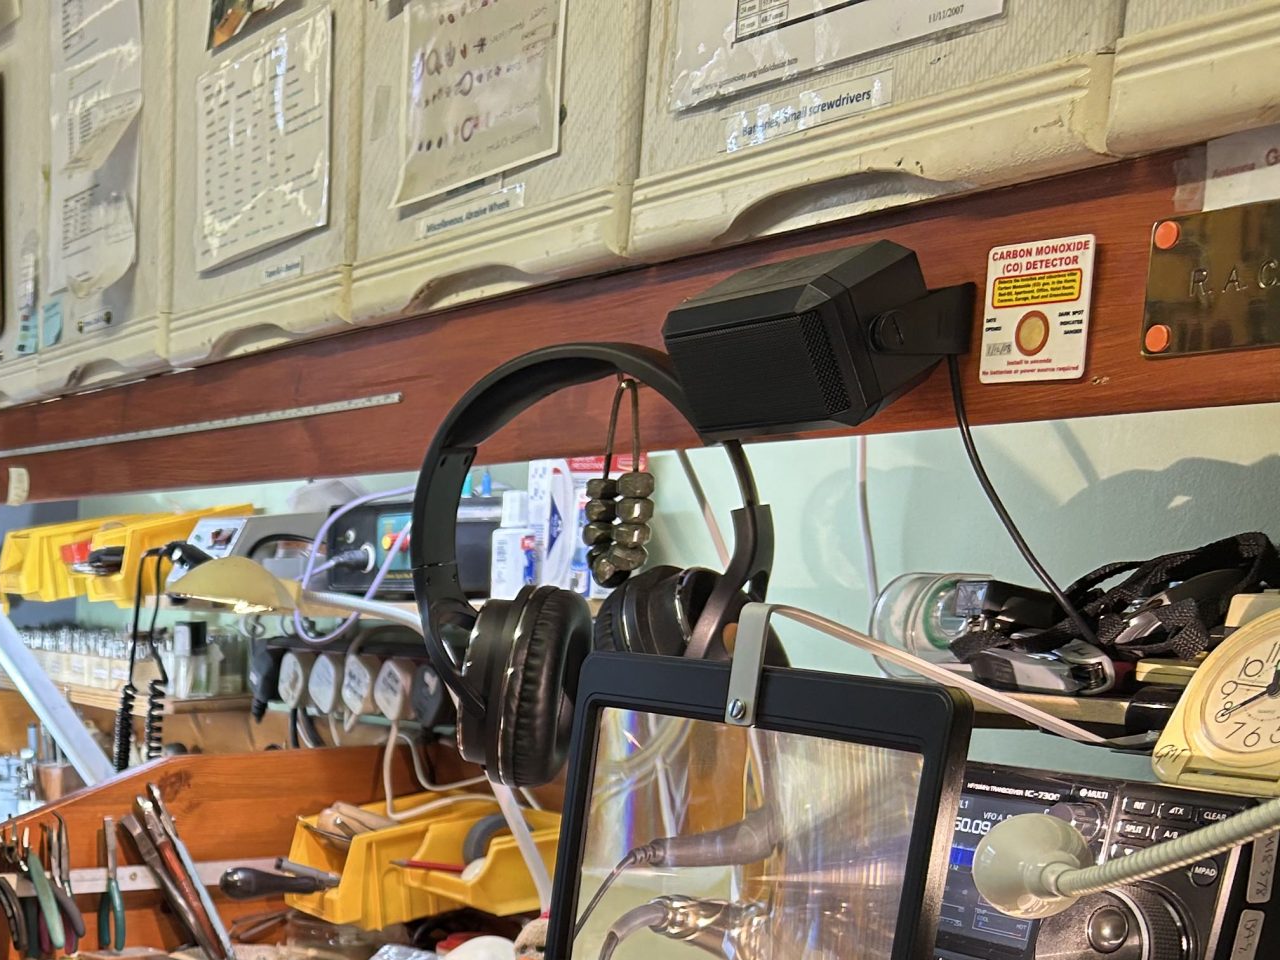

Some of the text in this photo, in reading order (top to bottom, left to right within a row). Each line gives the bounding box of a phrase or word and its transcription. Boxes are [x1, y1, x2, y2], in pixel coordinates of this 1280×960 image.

[809, 89, 872, 117] screwdrivers
[992, 240, 1091, 262] CARBON MONOXIDE
[1002, 255, 1080, 275] (CO) DETECTOR
[1238, 656, 1265, 679] 10
[1221, 680, 1239, 700] 9
[1214, 700, 1234, 724] 8
[1225, 721, 1247, 740] 7
[1243, 726, 1262, 748] 6
[983, 811, 997, 821] VFO
[1203, 809, 1227, 821] CLEAR
[1124, 823, 1144, 835] SPLIT
[1194, 865, 1217, 877] MPAD
